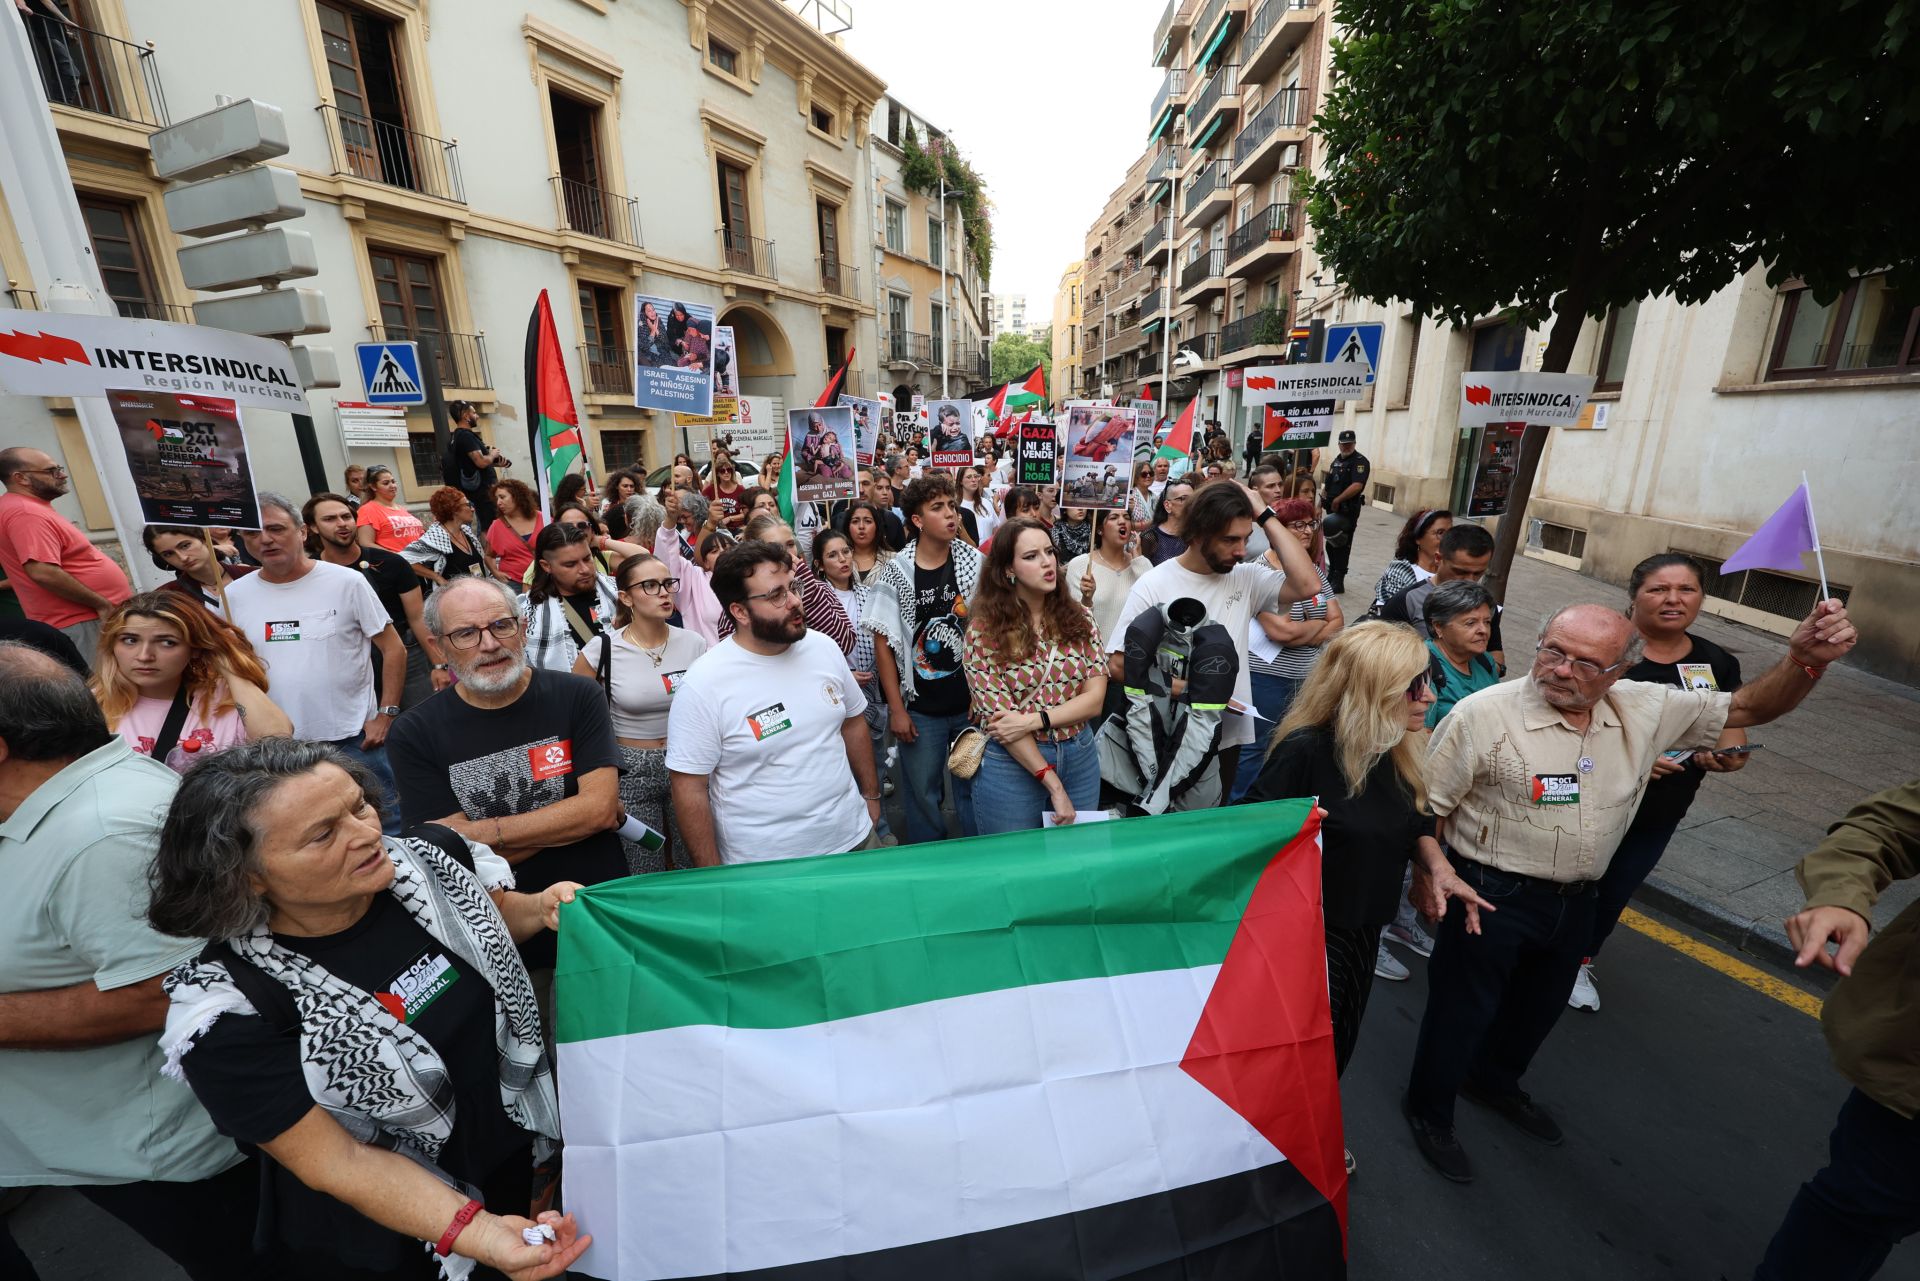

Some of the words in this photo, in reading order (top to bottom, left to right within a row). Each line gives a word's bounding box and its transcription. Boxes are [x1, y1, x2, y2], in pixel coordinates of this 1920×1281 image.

[94, 347, 297, 387] INTERSINDICAL
[643, 369, 670, 380] ISRAEL
[675, 374, 707, 385] ASESINO
[142, 374, 215, 391] Región
[222, 380, 301, 402] Murciana
[660, 379, 695, 392] NIÑOS/AS
[1278, 376, 1363, 391] INTERSINDICAL
[650, 388, 695, 400] PALESTINOS
[1291, 389, 1319, 398] Región
[1322, 387, 1362, 395] Murciana
[1272, 410, 1286, 418] DEL
[1287, 406, 1300, 417] RÍO
[1301, 408, 1311, 416] AL
[1313, 407, 1330, 415] MAR
[182, 421, 216, 435] OCT
[1280, 420, 1319, 428] PALESTINA
[145, 418, 185, 445] 15
[1022, 427, 1056, 439] GAZA
[184, 433, 220, 447] 24H
[1025, 441, 1037, 451] NI
[1041, 441, 1052, 451] SE
[157, 443, 203, 454] HUELGA
[1022, 450, 1054, 459] VENDE
[160, 452, 209, 462] GENERAL
[934, 453, 970, 464] GENOCIDIO
[1025, 462, 1036, 472] NI
[1041, 462, 1051, 472] SE
[1024, 471, 1050, 481] ROBA
[822, 490, 837, 498] GAZA
[270, 623, 285, 633] 15
[767, 706, 779, 716] OCT
[755, 711, 771, 727] 15
[761, 722, 788, 737] GENERAL
[1541, 777, 1560, 791] 15
[1558, 776, 1573, 784] OCT
[409, 953, 431, 976] OCT
[415, 961, 440, 984] 24H
[389, 969, 419, 1000] 15
[401, 976, 440, 1009] HUELGA
[407, 977, 450, 1015] GENERAL
